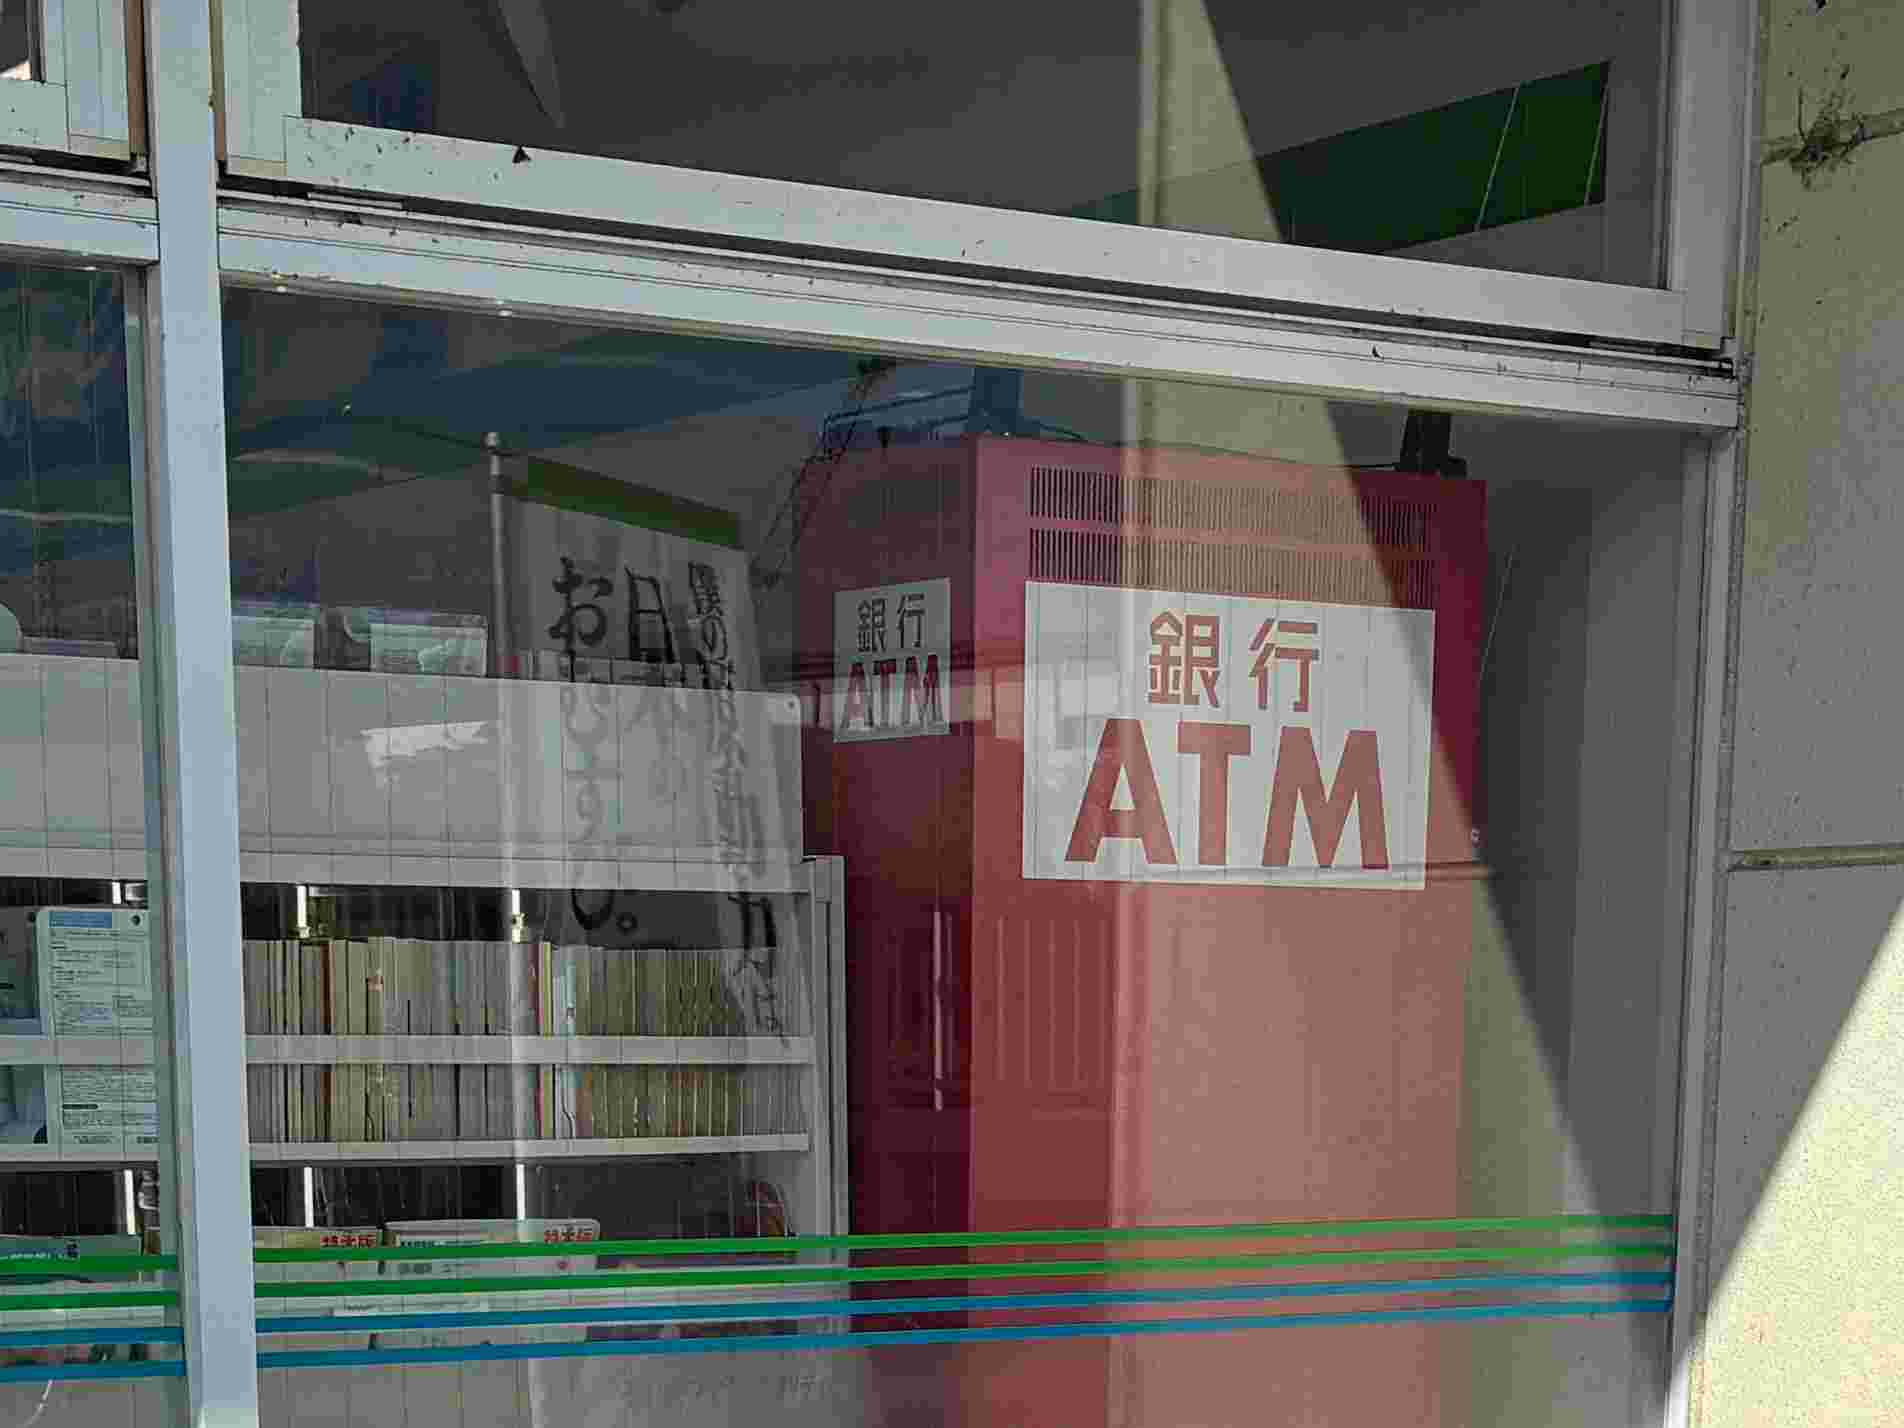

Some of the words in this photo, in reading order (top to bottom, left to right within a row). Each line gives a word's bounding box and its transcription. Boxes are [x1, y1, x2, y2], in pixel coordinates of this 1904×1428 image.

[857, 594, 925, 655] 銀行
[1149, 610, 1320, 712] 銀行
[842, 651, 941, 733] ATM
[1064, 719, 1390, 870] ATM
